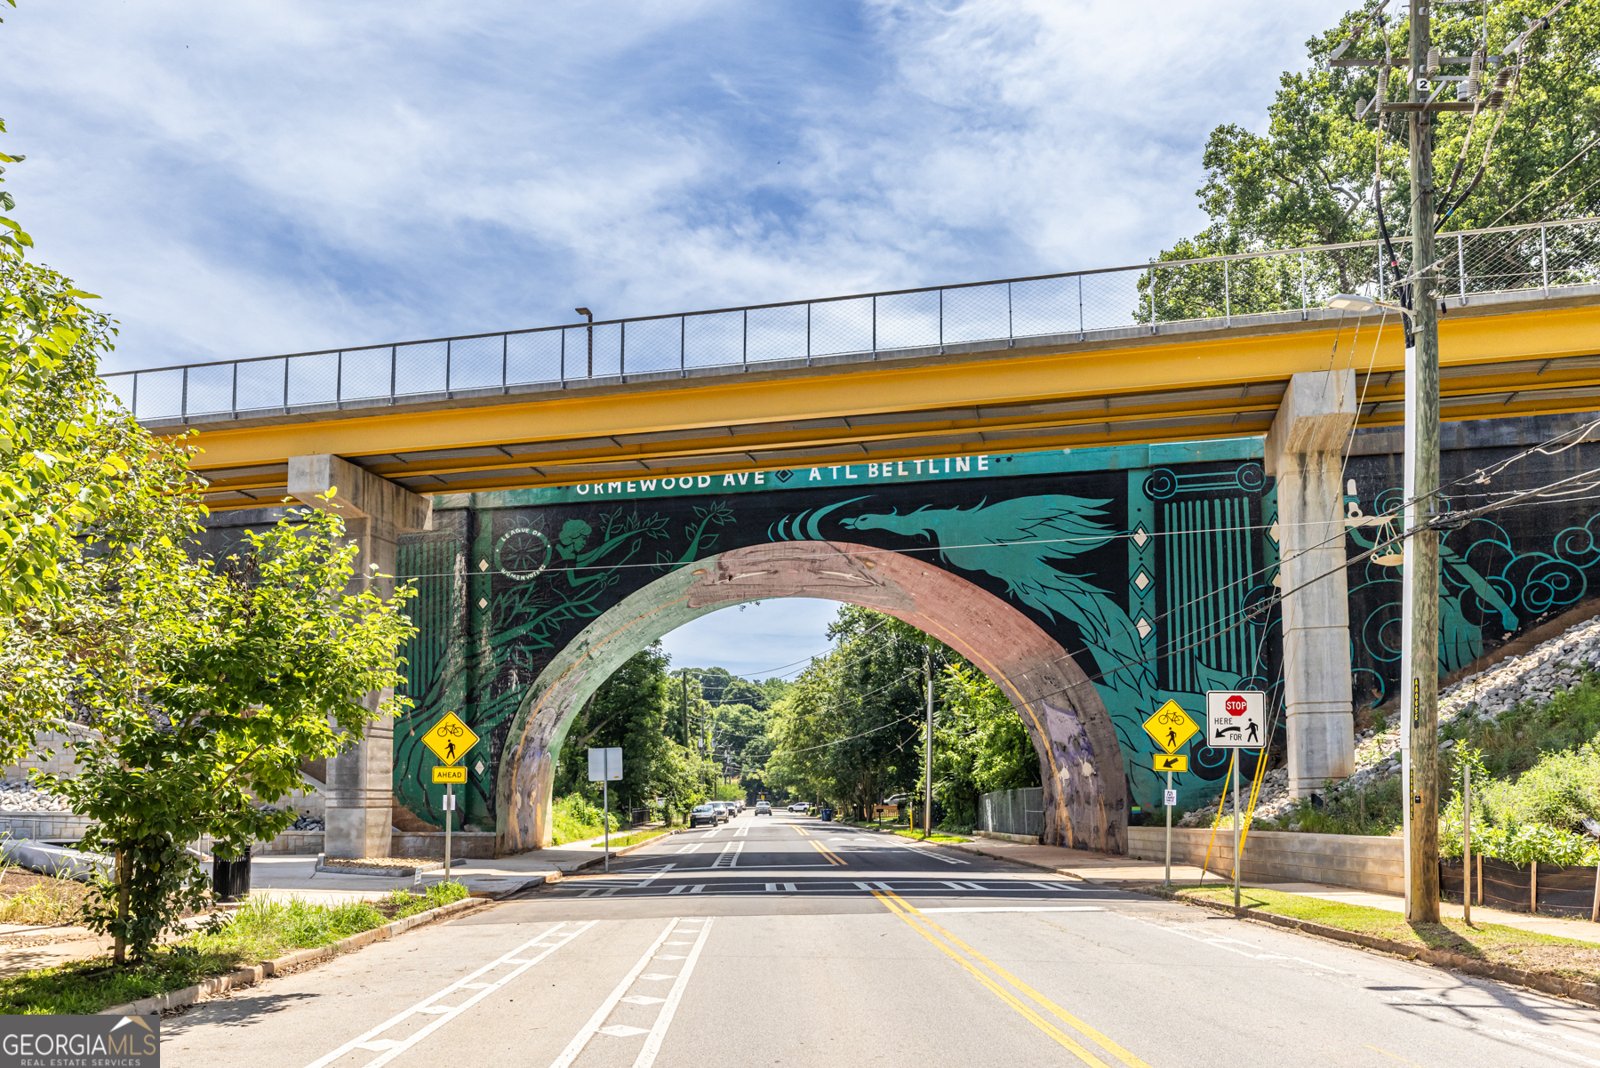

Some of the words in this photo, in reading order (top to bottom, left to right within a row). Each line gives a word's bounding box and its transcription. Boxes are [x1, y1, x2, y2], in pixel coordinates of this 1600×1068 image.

[1420, 80, 1428, 89] 2
[577, 475, 711, 495] ORMEWOOD
[722, 471, 765, 487] AVE
[808, 464, 858, 481] ATL
[868, 455, 989, 478] BELTLINE
[500, 527, 531, 542] LEAGUE
[500, 567, 525, 580] WOMEN
[1226, 701, 1247, 710] STOP
[1214, 717, 1233, 725] HERE
[1229, 733, 1242, 741] FOR
[437, 771, 462, 779] AHEAD
